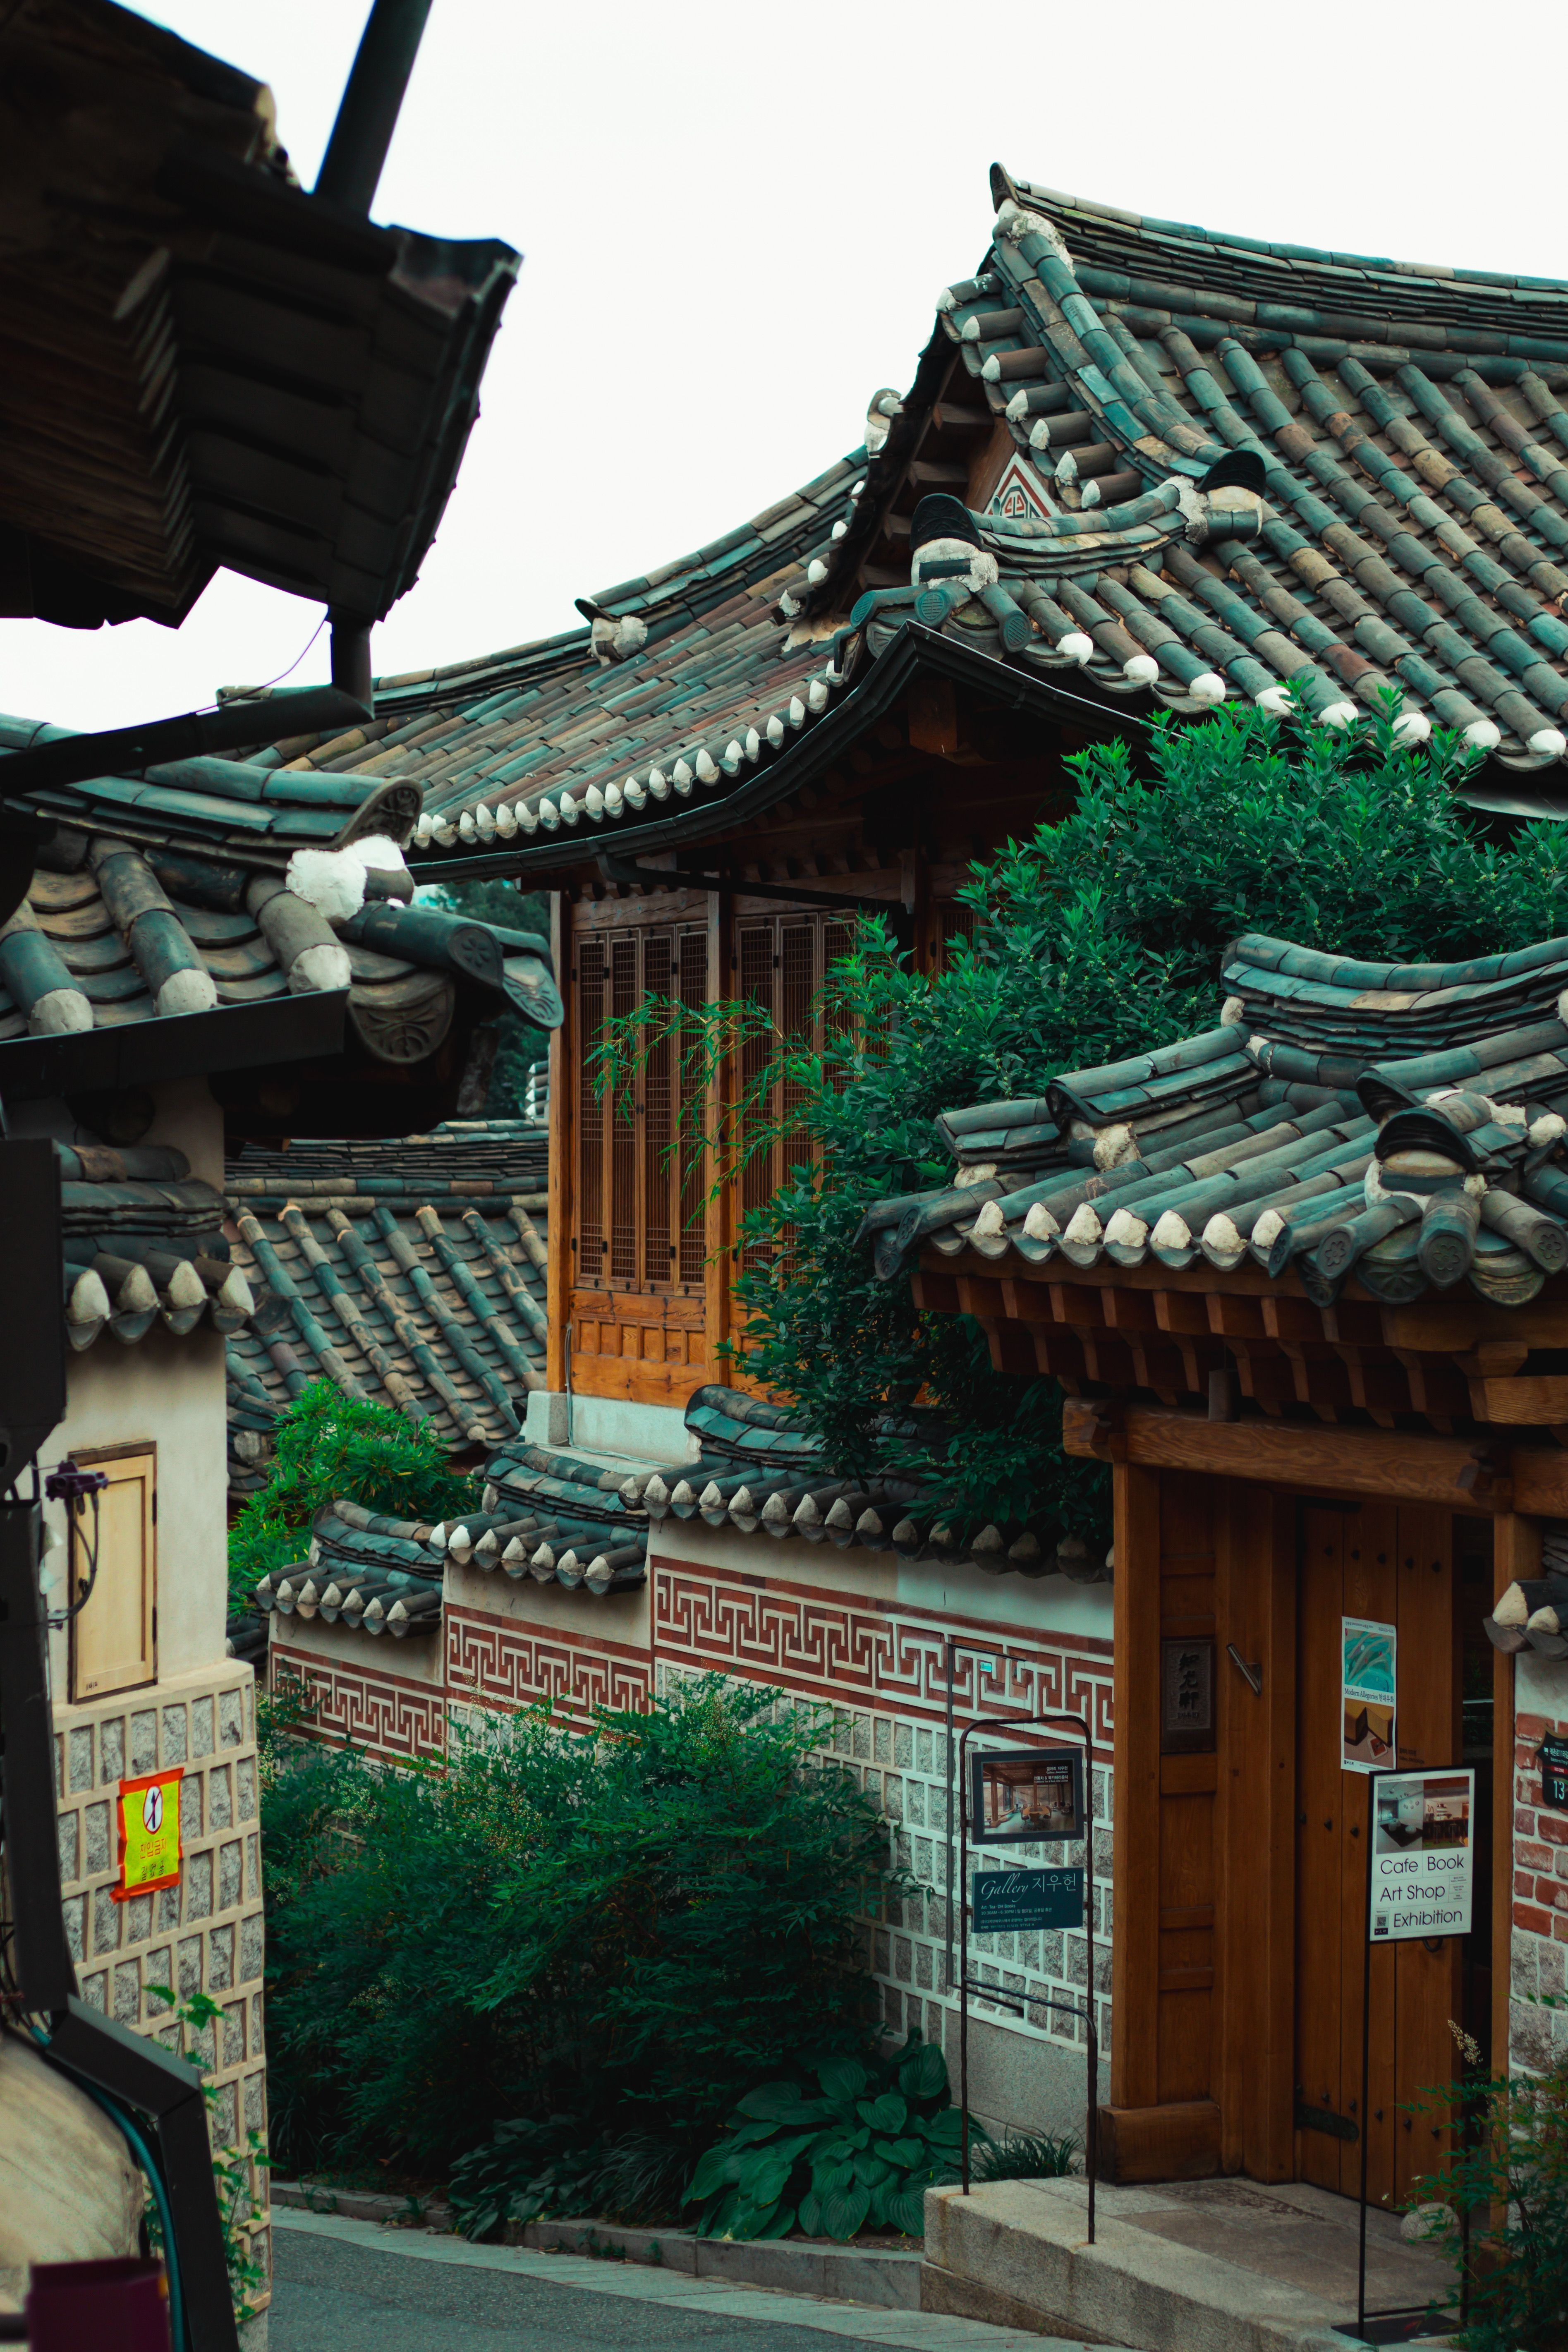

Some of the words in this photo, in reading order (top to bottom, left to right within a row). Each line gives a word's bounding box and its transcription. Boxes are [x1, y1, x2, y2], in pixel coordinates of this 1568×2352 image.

[1344, 1688, 1360, 1696] Modern
[1360, 1691, 1378, 1700] Allegories
[1379, 1694, 1394, 1703] 현대우화
[1554, 1780, 1565, 1800] 13
[140, 1837, 167, 1859] 진입금지
[1380, 1858, 1418, 1874] Cafe
[1428, 1854, 1464, 1871] Book
[981, 1873, 1028, 1903] Gallery
[1032, 1873, 1076, 1892] 지우헌
[1380, 1886, 1403, 1902] Art
[1407, 1885, 1445, 1901] Shop
[1394, 1909, 1462, 1928] Exhibition
